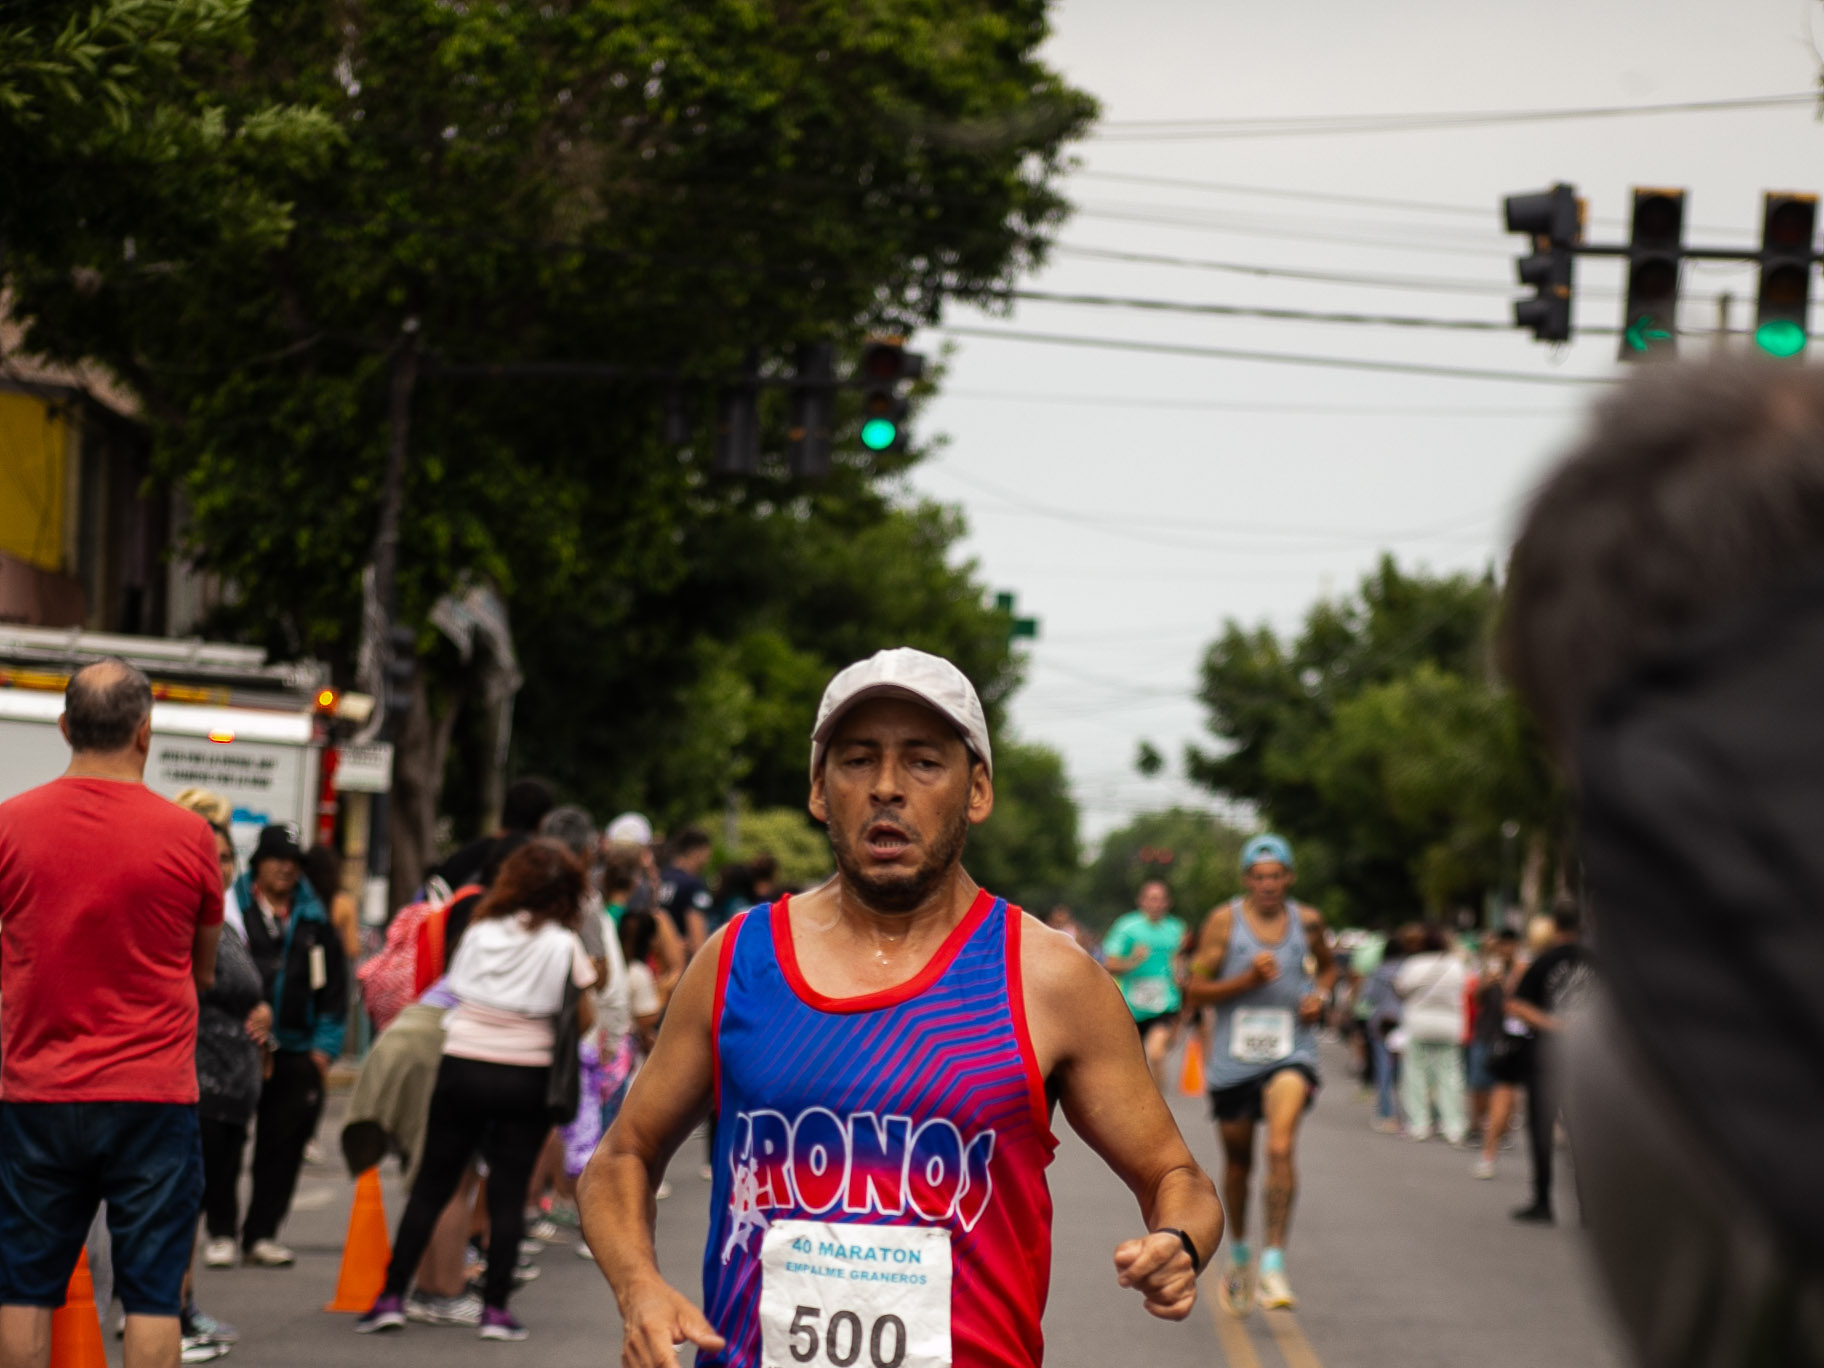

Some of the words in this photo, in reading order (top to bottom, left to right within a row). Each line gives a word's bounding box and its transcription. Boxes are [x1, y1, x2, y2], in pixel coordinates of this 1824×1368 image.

[791, 1238, 812, 1254] 40
[818, 1241, 922, 1264] MARATON
[785, 1261, 845, 1279] EMPALME
[850, 1270, 928, 1286] GRANEROS
